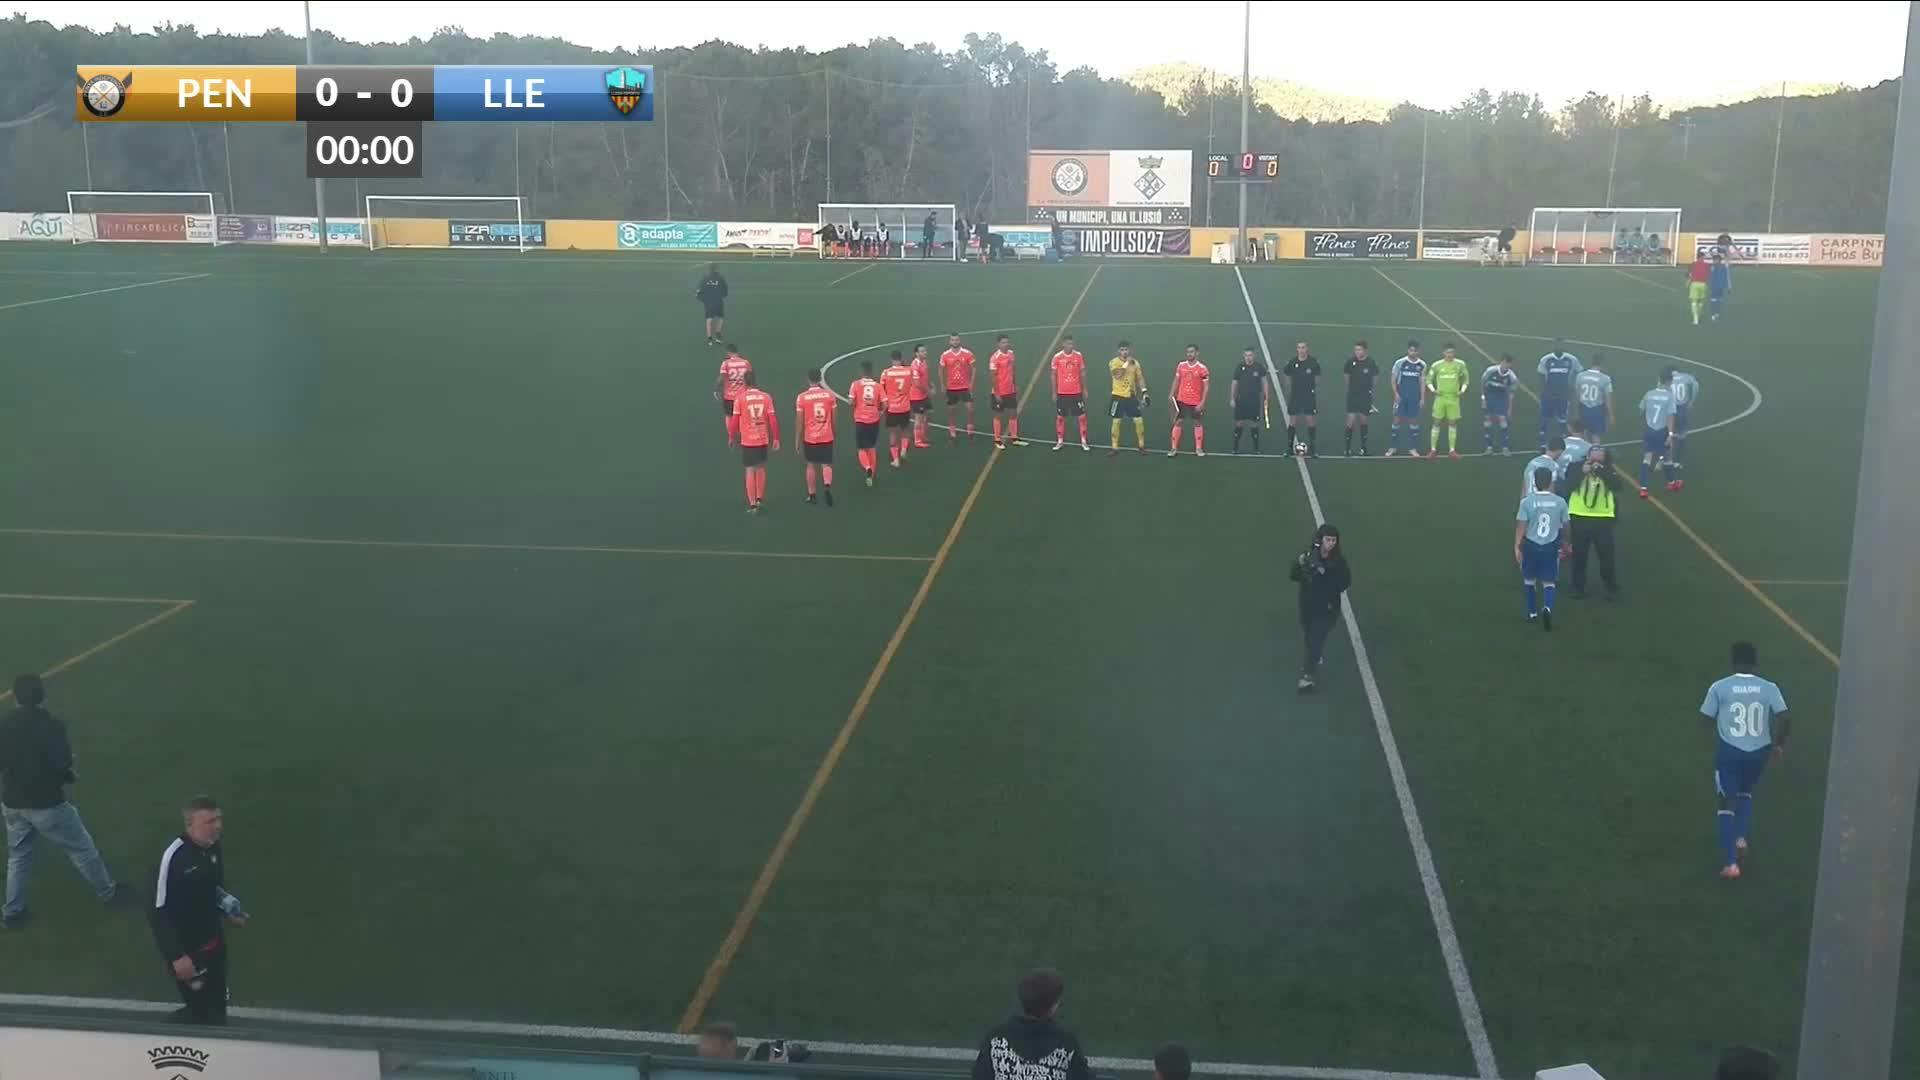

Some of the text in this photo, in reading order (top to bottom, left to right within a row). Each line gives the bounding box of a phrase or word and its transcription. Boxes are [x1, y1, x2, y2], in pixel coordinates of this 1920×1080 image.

[1209, 161, 1219, 176] 0
[1267, 161, 1278, 176] 0
[641, 228, 684, 241] adapta
[1080, 230, 1164, 253] IMPULSO27
[863, 386, 874, 399] 8
[1581, 383, 1598, 401] 20
[747, 403, 765, 419] 17
[1652, 404, 1661, 424] 7
[1537, 512, 1550, 537] 8
[1729, 701, 1764, 737] 30
